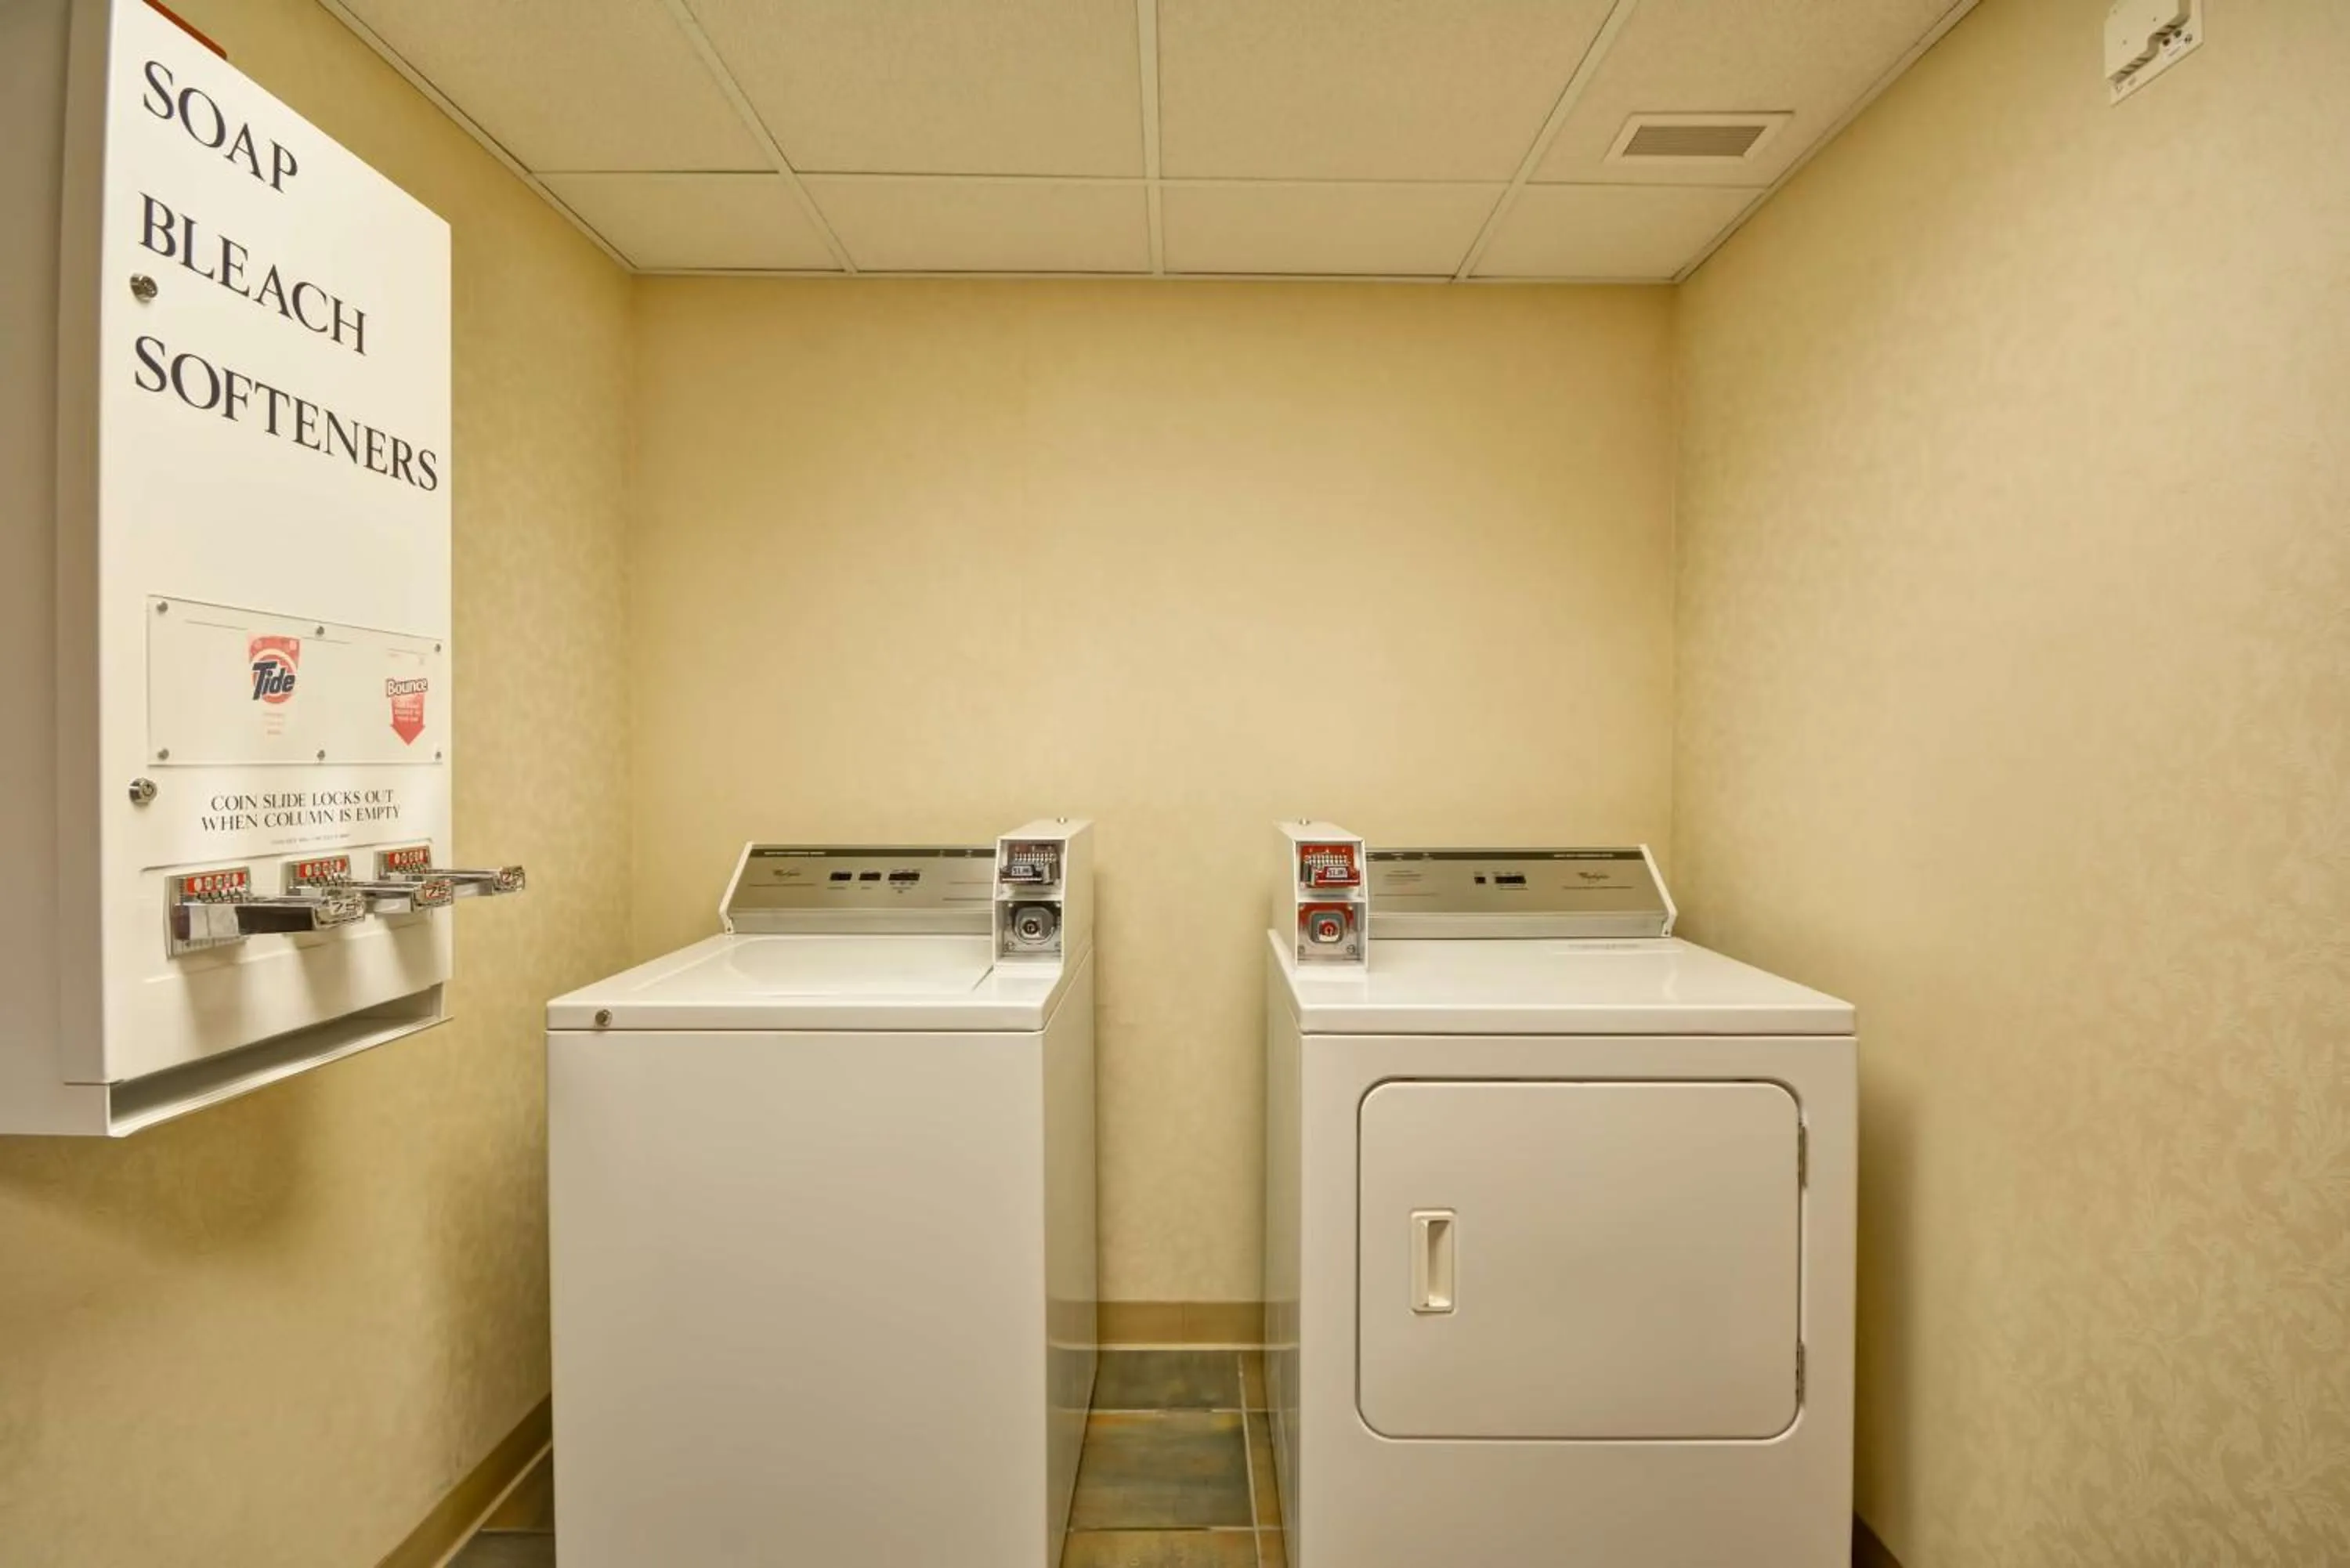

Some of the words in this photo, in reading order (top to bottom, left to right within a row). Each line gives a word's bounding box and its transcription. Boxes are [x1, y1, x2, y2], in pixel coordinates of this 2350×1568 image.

[143, 60, 298, 193] SOAP
[139, 192, 367, 356] BLEACH
[134, 335, 439, 492] SOFTENERS
[251, 660, 295, 700] Tide
[385, 677, 428, 697] Bounce
[201, 814, 258, 832] WHEN
[264, 808, 335, 828] COLUMN
[339, 808, 352, 822] IS
[356, 804, 401, 822] EMPTY
[211, 794, 258, 811] COIN
[262, 793, 306, 809] SLIDE
[313, 790, 360, 806] LOCKS
[364, 789, 394, 804] OUT
